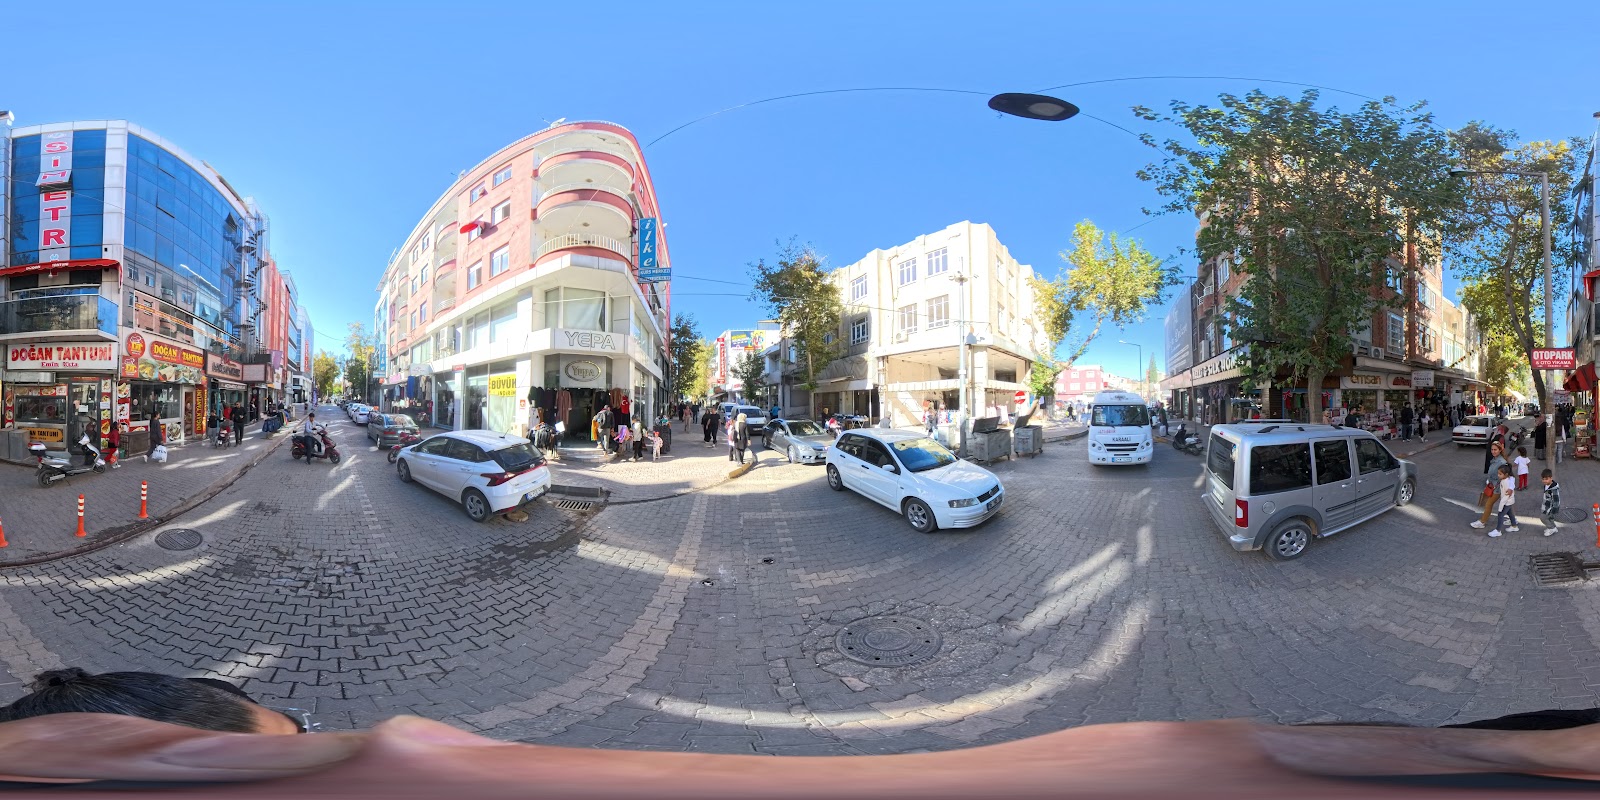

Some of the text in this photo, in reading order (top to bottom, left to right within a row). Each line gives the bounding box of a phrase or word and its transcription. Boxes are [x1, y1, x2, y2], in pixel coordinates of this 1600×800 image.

[643, 219, 653, 267] ilke
[564, 331, 615, 350] YEPA
[11, 344, 112, 361] DOĞAN TANTUNİ
[154, 344, 178, 357] DOĞAN
[1533, 351, 1573, 360] OTOPARK
[1350, 375, 1381, 384] emsan
